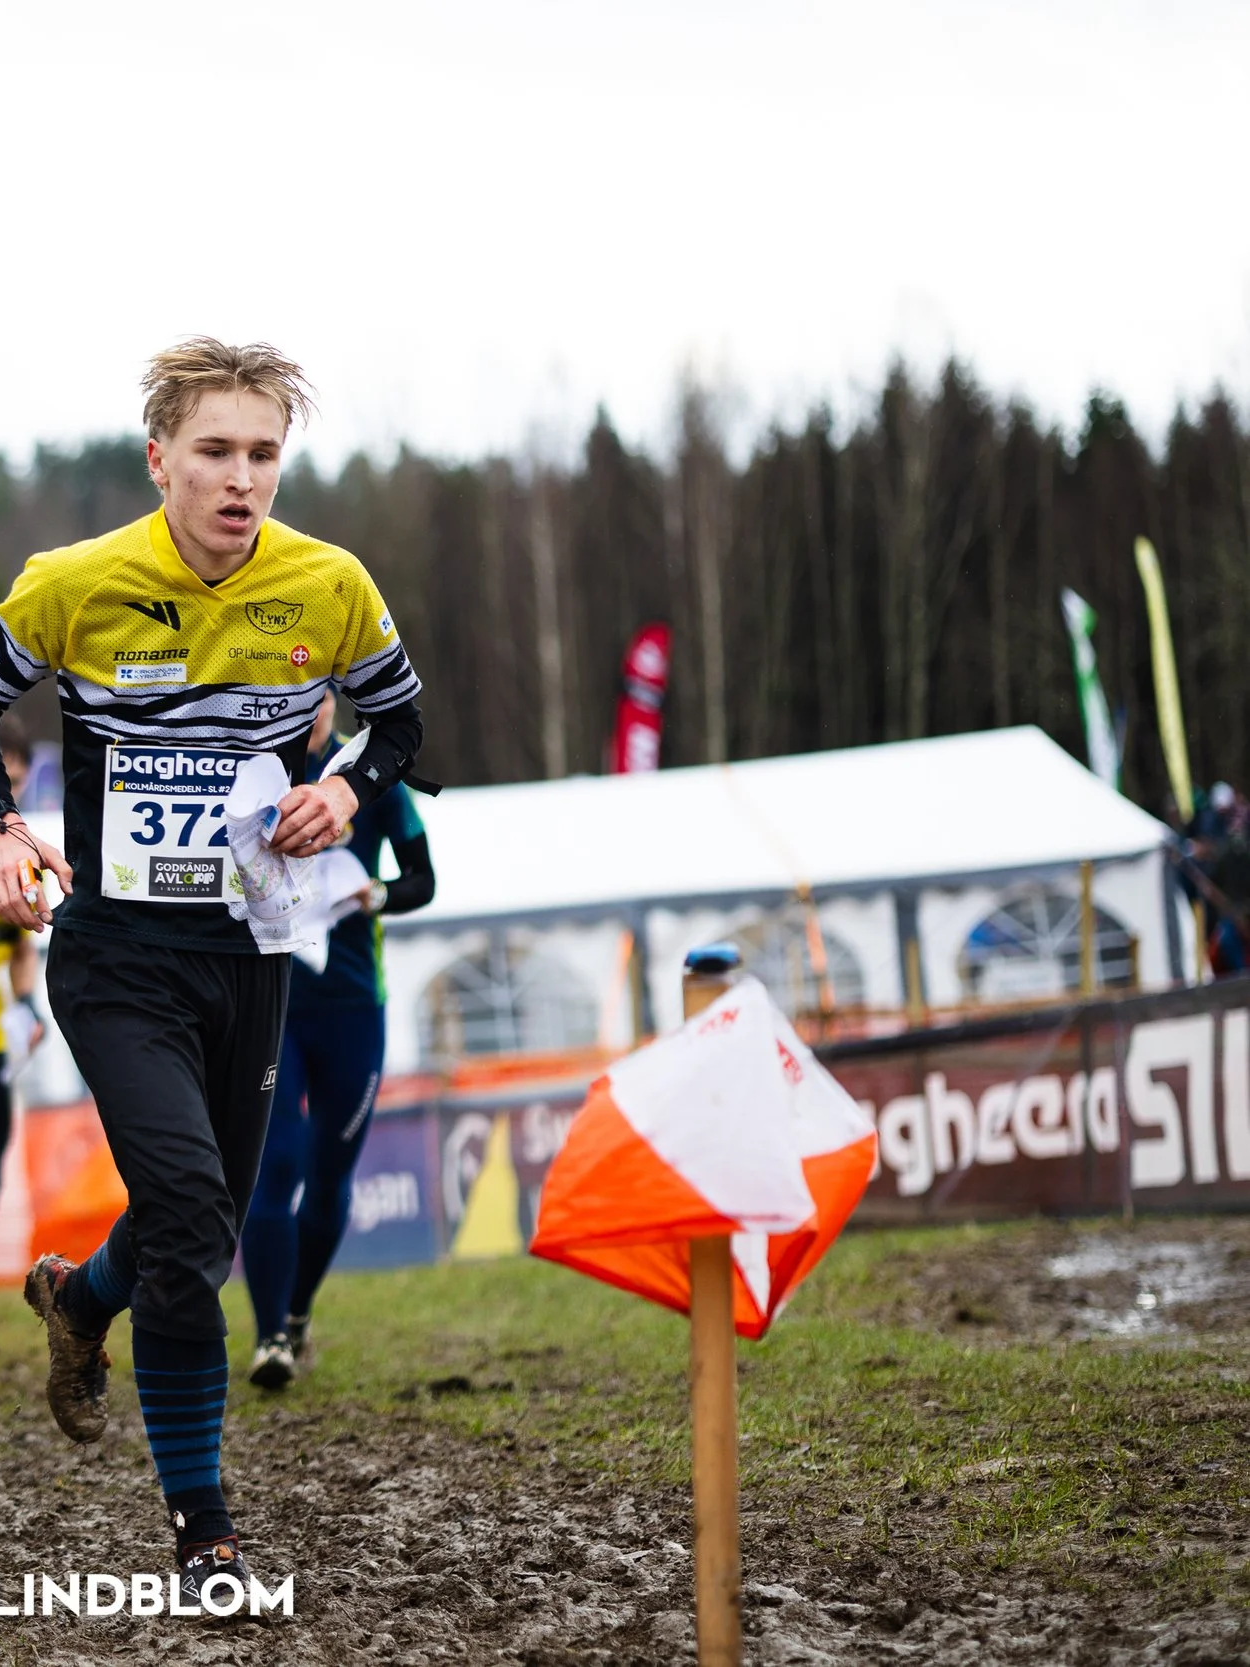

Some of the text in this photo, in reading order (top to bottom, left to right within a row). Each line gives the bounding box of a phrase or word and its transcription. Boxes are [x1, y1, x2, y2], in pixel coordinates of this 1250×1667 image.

[260, 614, 288, 625] LYNX
[113, 648, 190, 661] noname
[228, 647, 288, 661] OP Uusimaa
[124, 781, 202, 793] KOLMÅRDSMEDELN
[208, 785, 218, 793] SL
[155, 861, 217, 873] GODKÄNDA
[154, 872, 215, 885] AVLOPP
[860, 1066, 1120, 1197] gheera
